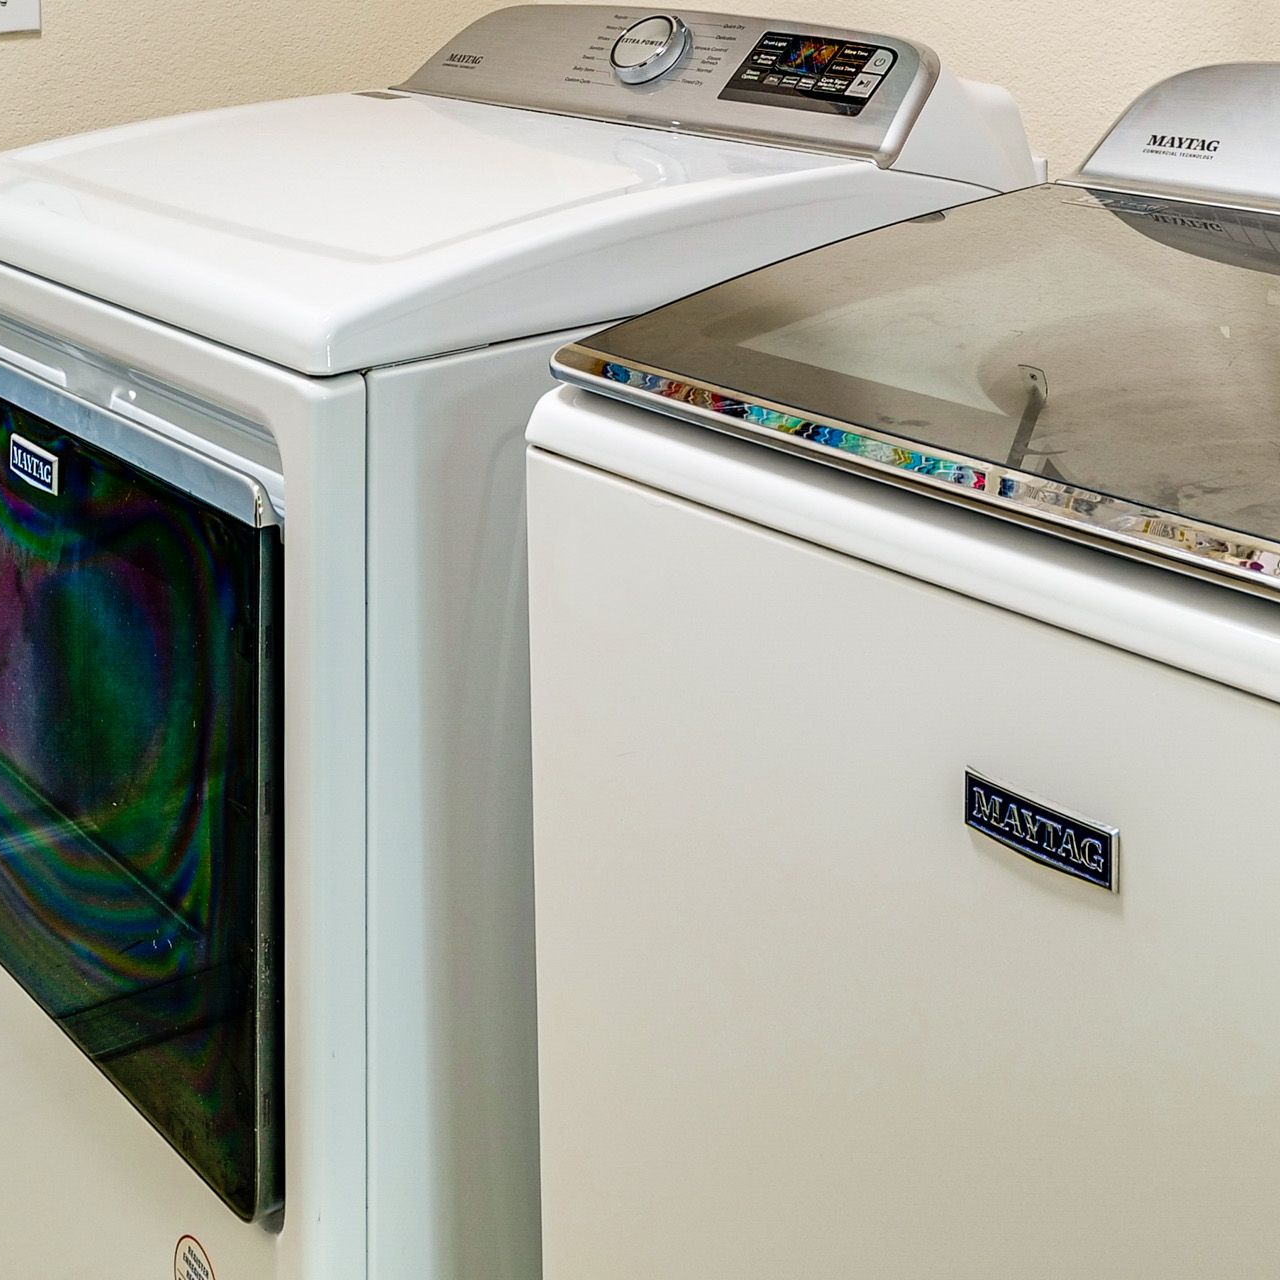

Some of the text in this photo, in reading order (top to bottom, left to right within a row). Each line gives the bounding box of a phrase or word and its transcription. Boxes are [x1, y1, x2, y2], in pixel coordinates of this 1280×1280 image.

[621, 37, 640, 45] EXTRA
[446, 53, 483, 64] MAYTAG
[1146, 134, 1220, 152] MAYTAG
[1180, 152, 1214, 160] TECHNOLOGY
[13, 446, 51, 483] MAYTAG
[972, 786, 1105, 872] MAYTAG
